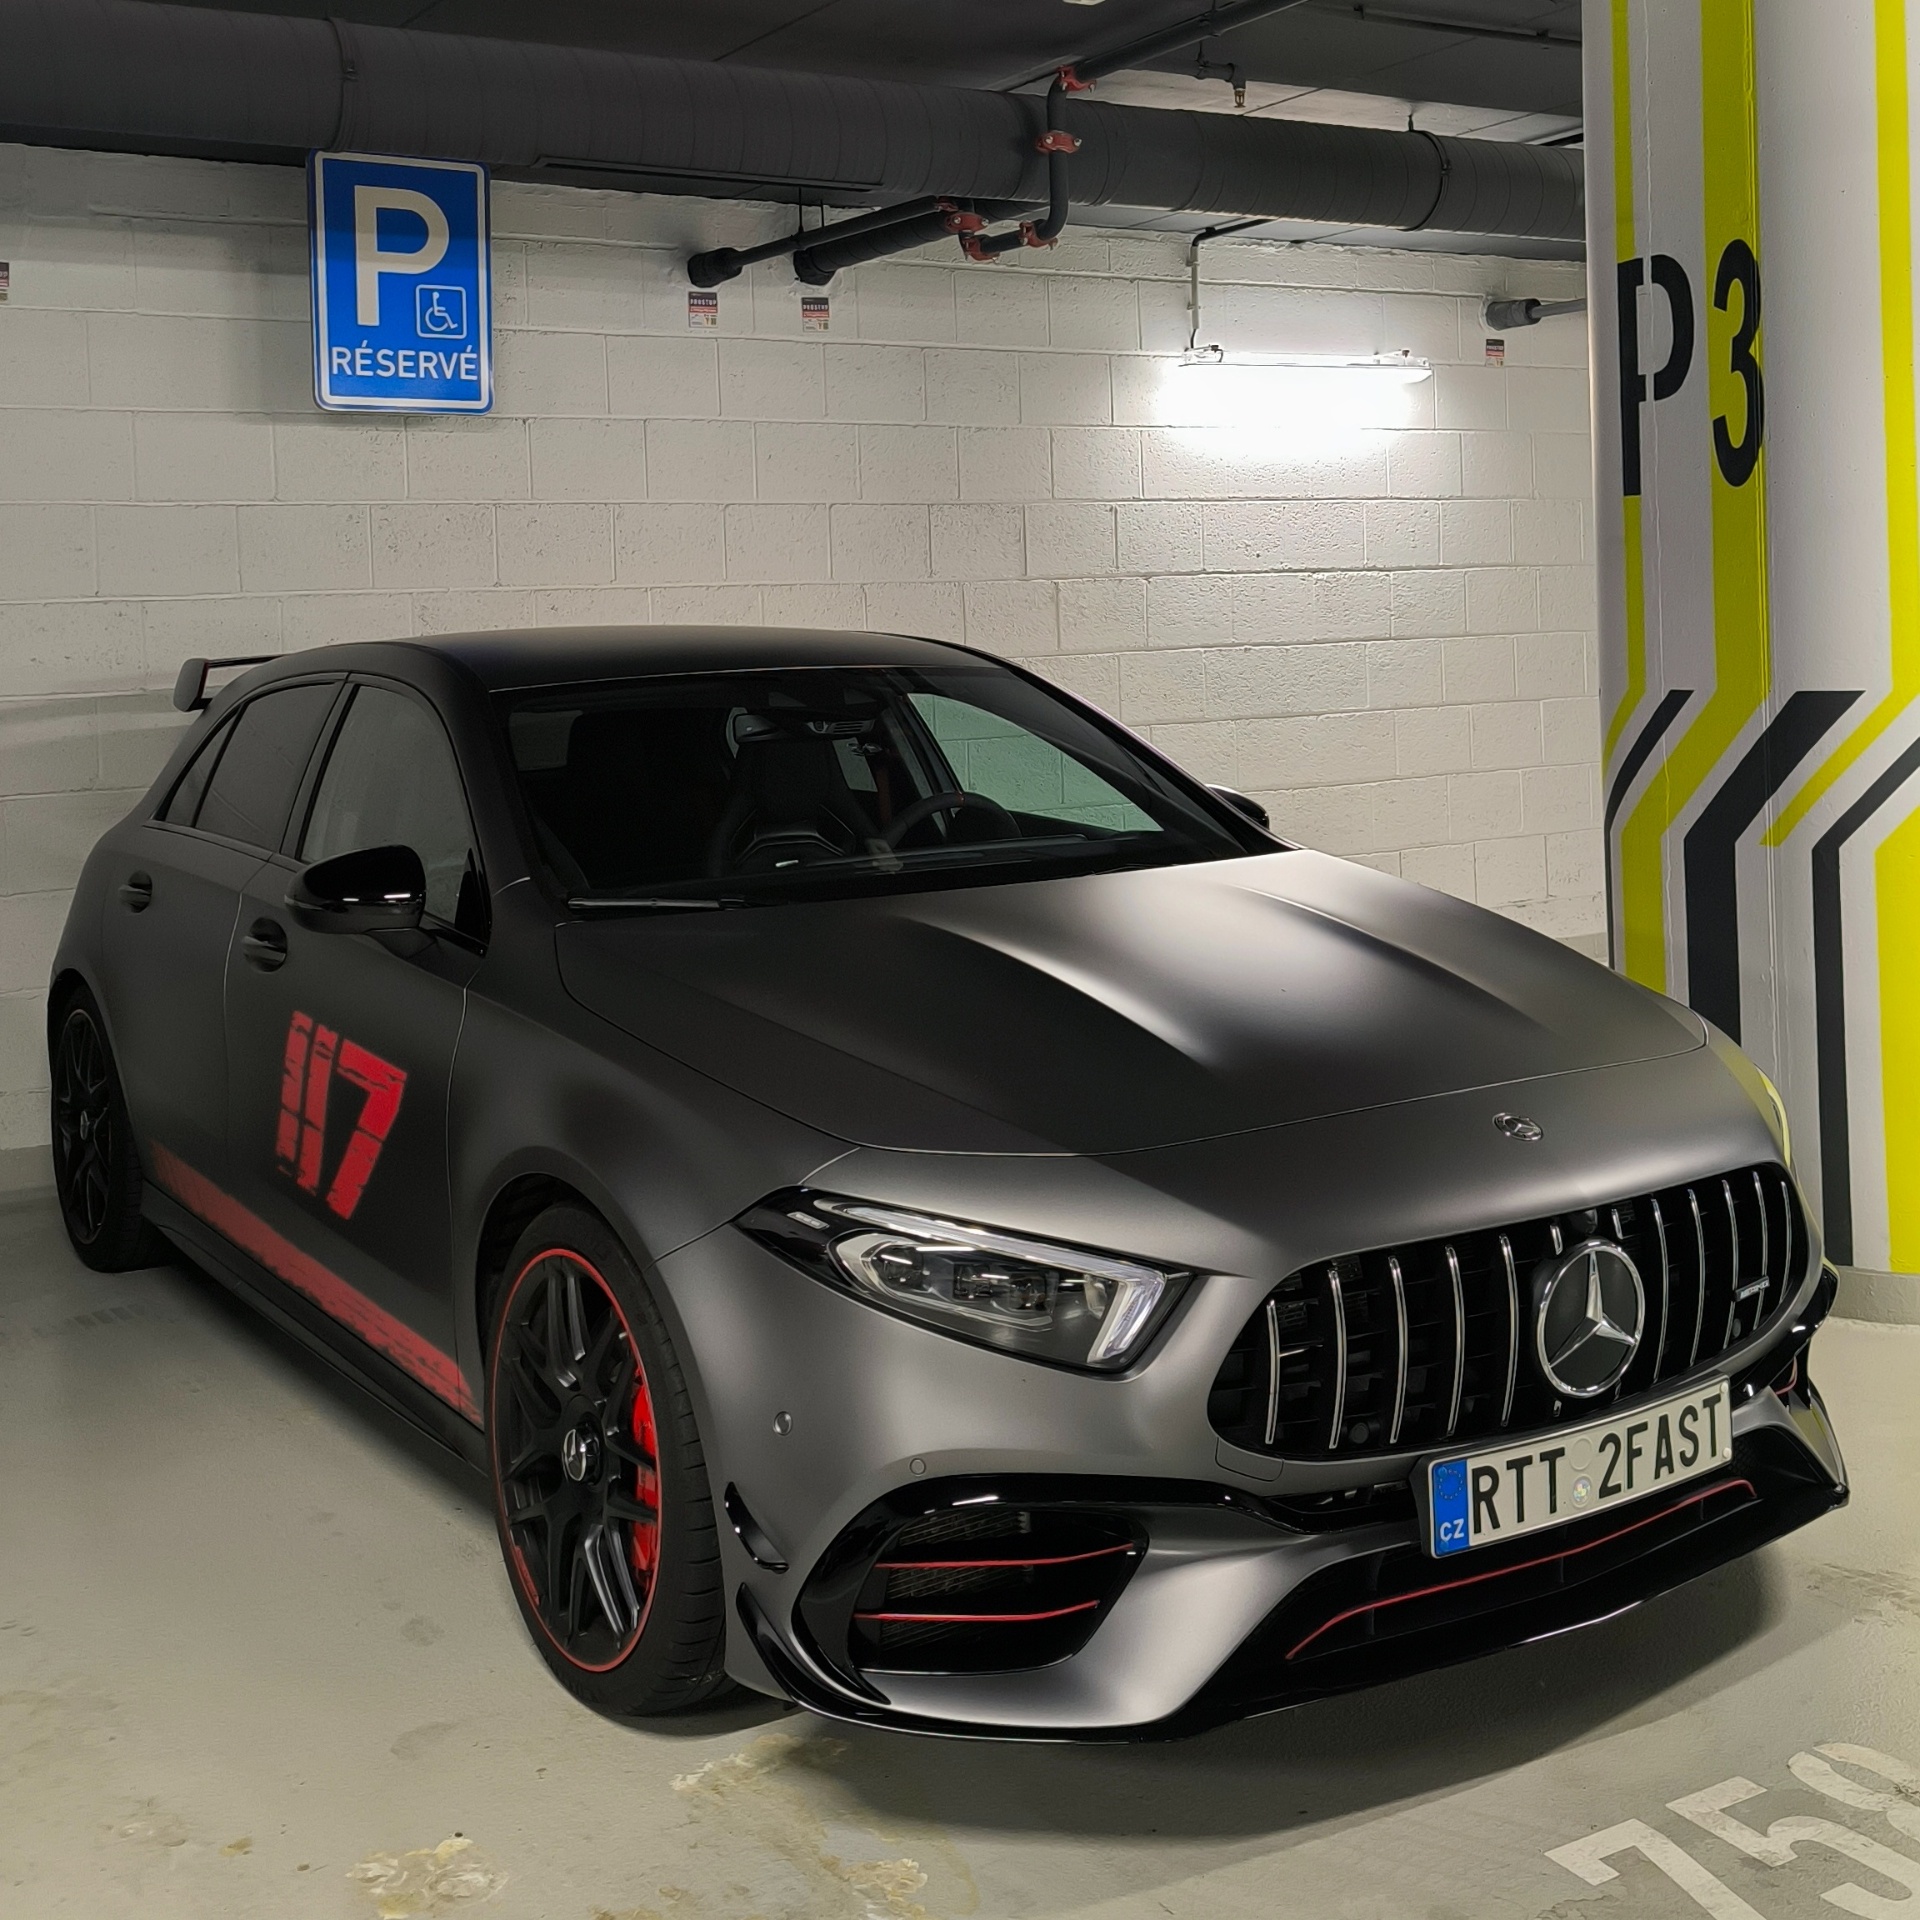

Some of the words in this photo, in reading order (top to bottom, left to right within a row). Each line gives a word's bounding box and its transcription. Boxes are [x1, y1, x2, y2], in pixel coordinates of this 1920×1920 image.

[354, 184, 449, 327] P
[331, 339, 478, 381] RÉSERVÉ
[1439, 1518, 1465, 1542] CZ
[1471, 1447, 1566, 1535] RTT
[1598, 1393, 1722, 1500] 2FAST
